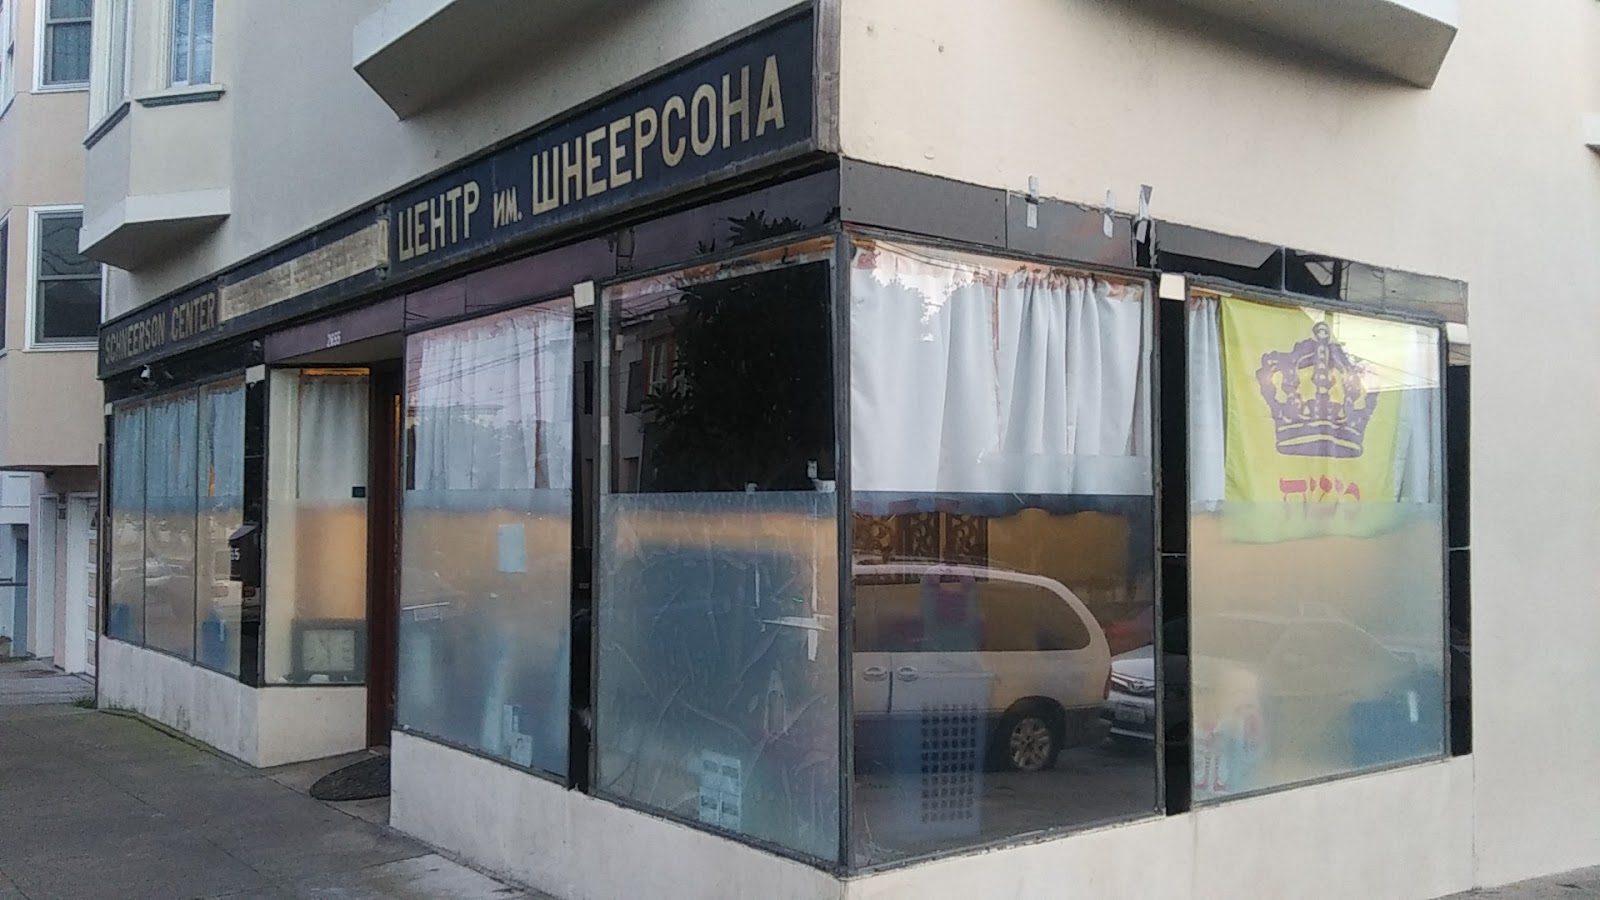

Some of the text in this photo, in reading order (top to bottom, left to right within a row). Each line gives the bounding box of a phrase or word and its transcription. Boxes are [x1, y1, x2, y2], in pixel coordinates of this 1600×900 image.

[398, 180, 480, 262] ЦЕНТР
[531, 54, 786, 216] ШНЕЕРСОНА
[105, 292, 216, 365] SCHNEERSON CENTER
